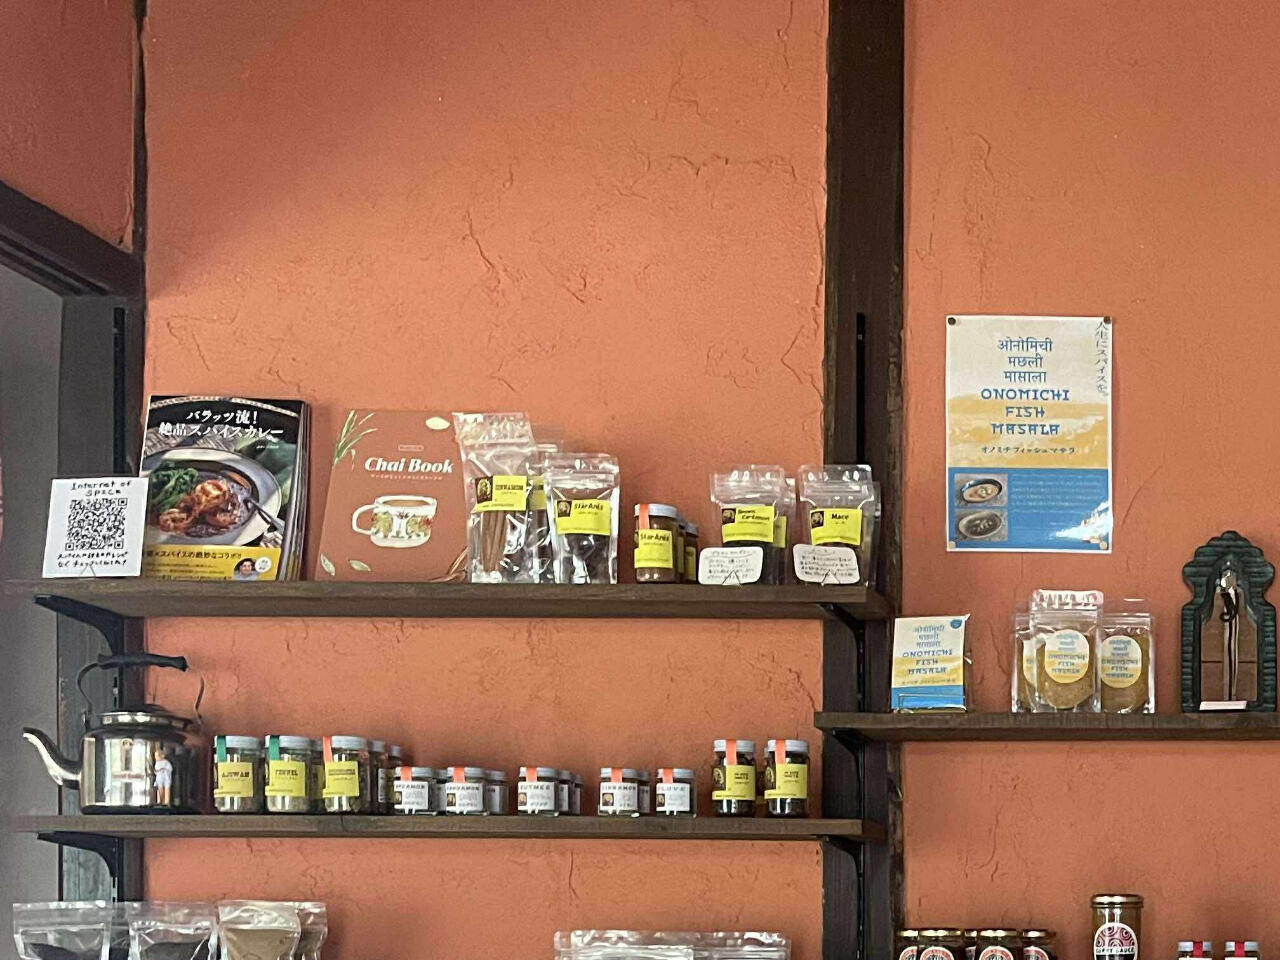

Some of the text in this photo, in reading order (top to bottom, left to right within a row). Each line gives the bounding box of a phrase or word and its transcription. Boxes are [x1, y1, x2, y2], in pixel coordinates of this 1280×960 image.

[1008, 353, 1043, 368] मछली
[980, 388, 1070, 401] ONOMICHI
[1005, 406, 1045, 418] FISH
[991, 423, 1060, 435] MASALA
[364, 456, 454, 473] Chai Book
